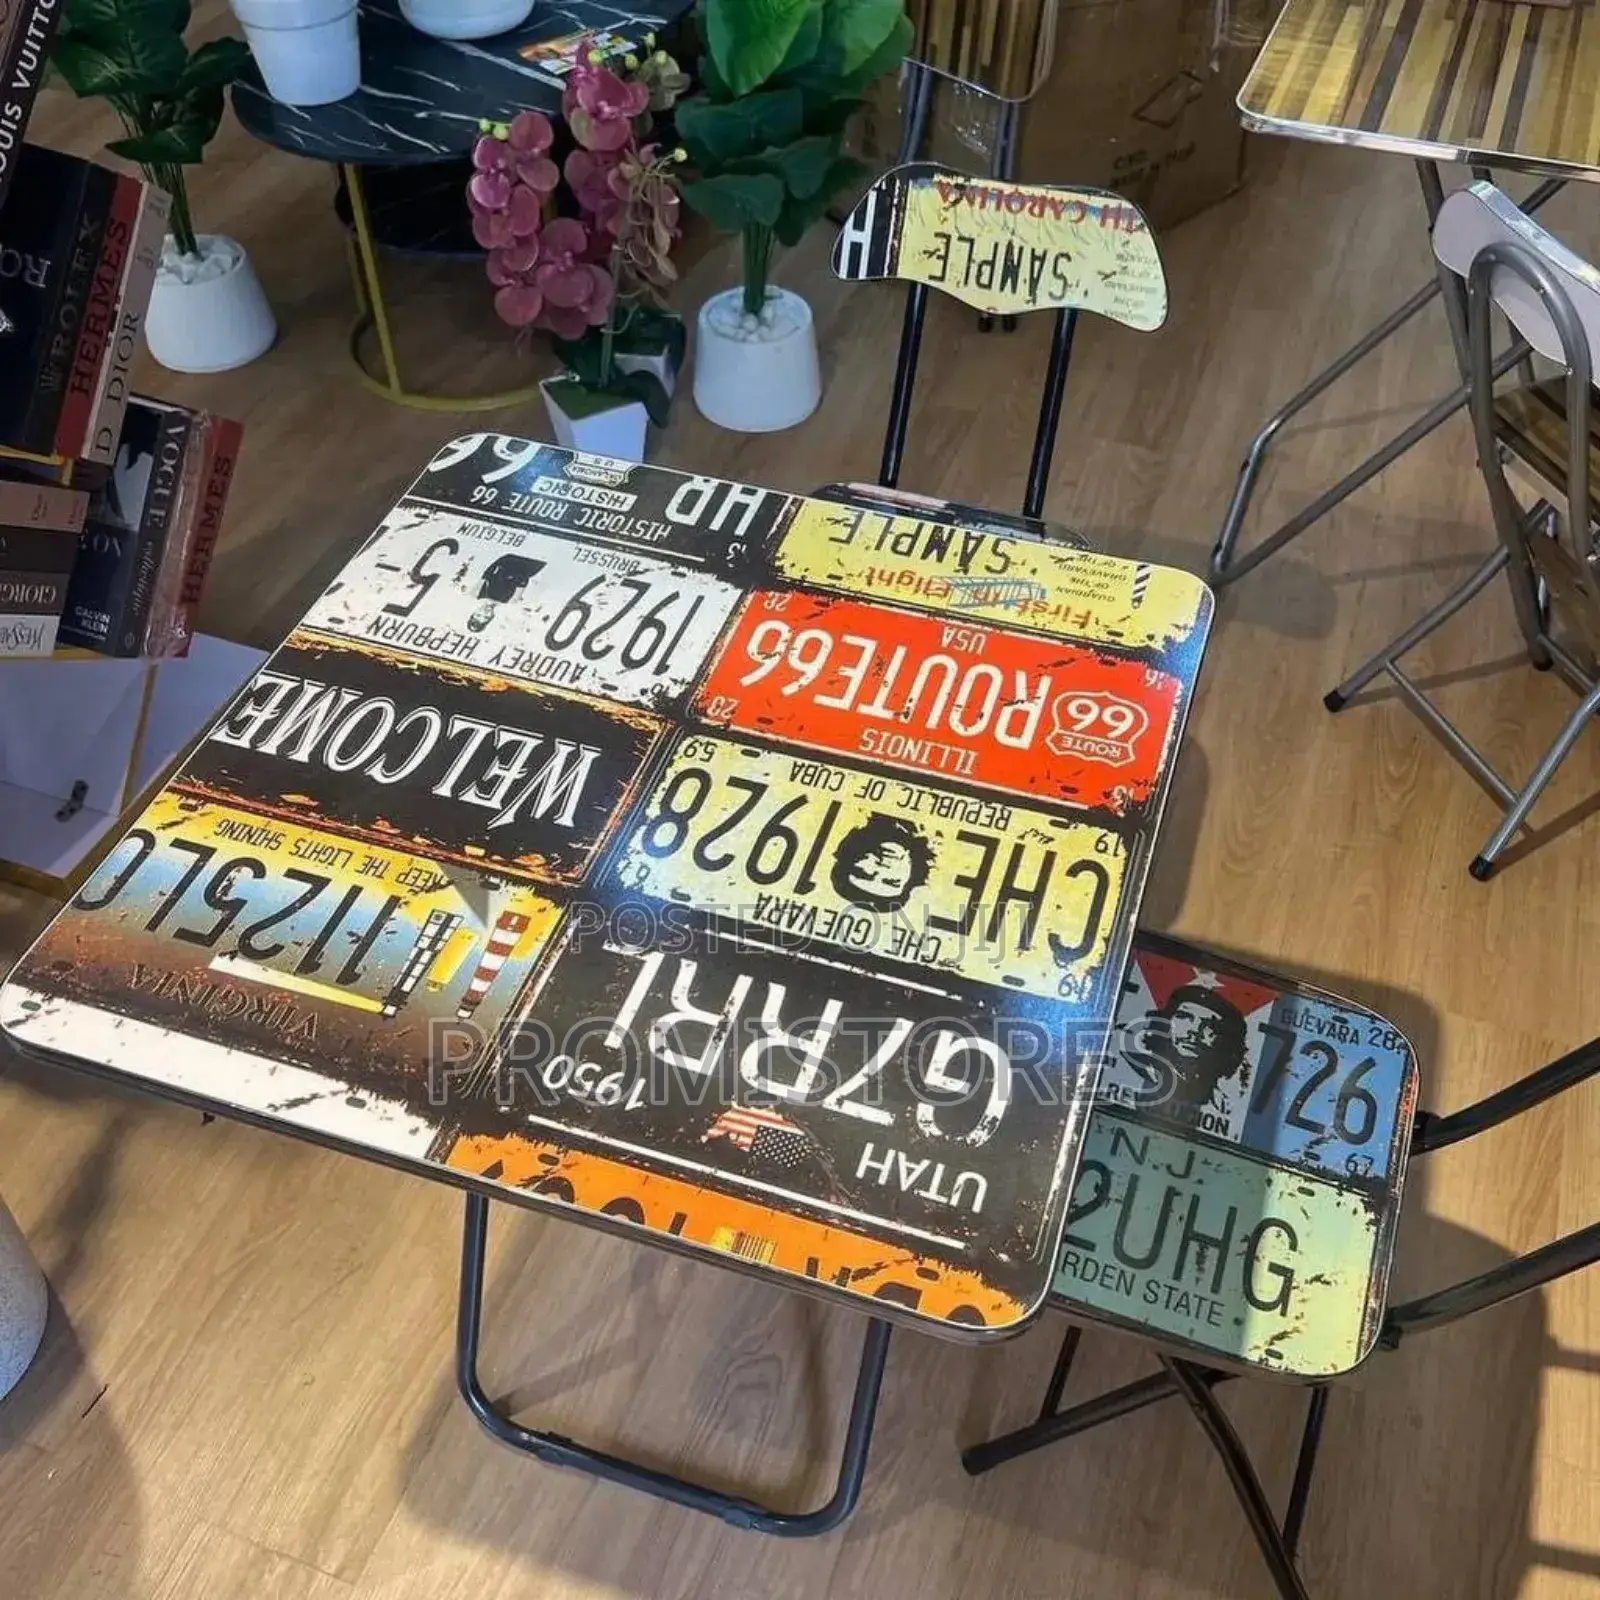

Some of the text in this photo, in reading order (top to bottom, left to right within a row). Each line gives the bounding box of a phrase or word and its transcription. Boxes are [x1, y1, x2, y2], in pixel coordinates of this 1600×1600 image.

[0, 0, 56, 179] OUIS VUITTO
[935, 179, 1087, 225] CAROLINA
[929, 232, 1072, 303] SAMPLE
[70, 220, 128, 396] HERMES
[107, 312, 140, 402] DIOR
[471, 485, 672, 542] HISTORIC ROUTE 66
[537, 477, 629, 509] HISTORIC
[457, 520, 526, 548] BELGIUM
[572, 544, 641, 574] BRUSSEL
[828, 507, 1017, 576] SAMPLE
[0, 583, 57, 604] GIORG
[866, 566, 952, 599] Flight
[1015, 597, 1093, 630] First
[365, 613, 588, 685] AUDREY HEPBURN
[543, 574, 706, 677] 1929
[941, 624, 987, 653] USA
[740, 619, 1051, 751] ROUTE66
[209, 670, 603, 829] WELCOME
[1059, 733, 1124, 757] ROUTE
[1065, 698, 1134, 739] 66
[861, 728, 979, 776] ILLINOIS
[789, 761, 1013, 830] REPUBLIC OF CUBA
[214, 818, 454, 895] KEEP THE LIGHTS SHINING
[642, 768, 1111, 966] CHE 1928
[752, 891, 942, 963] CHE GUEVARA
[131, 963, 318, 1041] VIRGINIA
[1280, 1006, 1361, 1046] GUEVARA
[542, 1054, 647, 1111] 1950
[857, 1142, 989, 1214] UTAH
[1142, 1279, 1226, 1328] STATE
